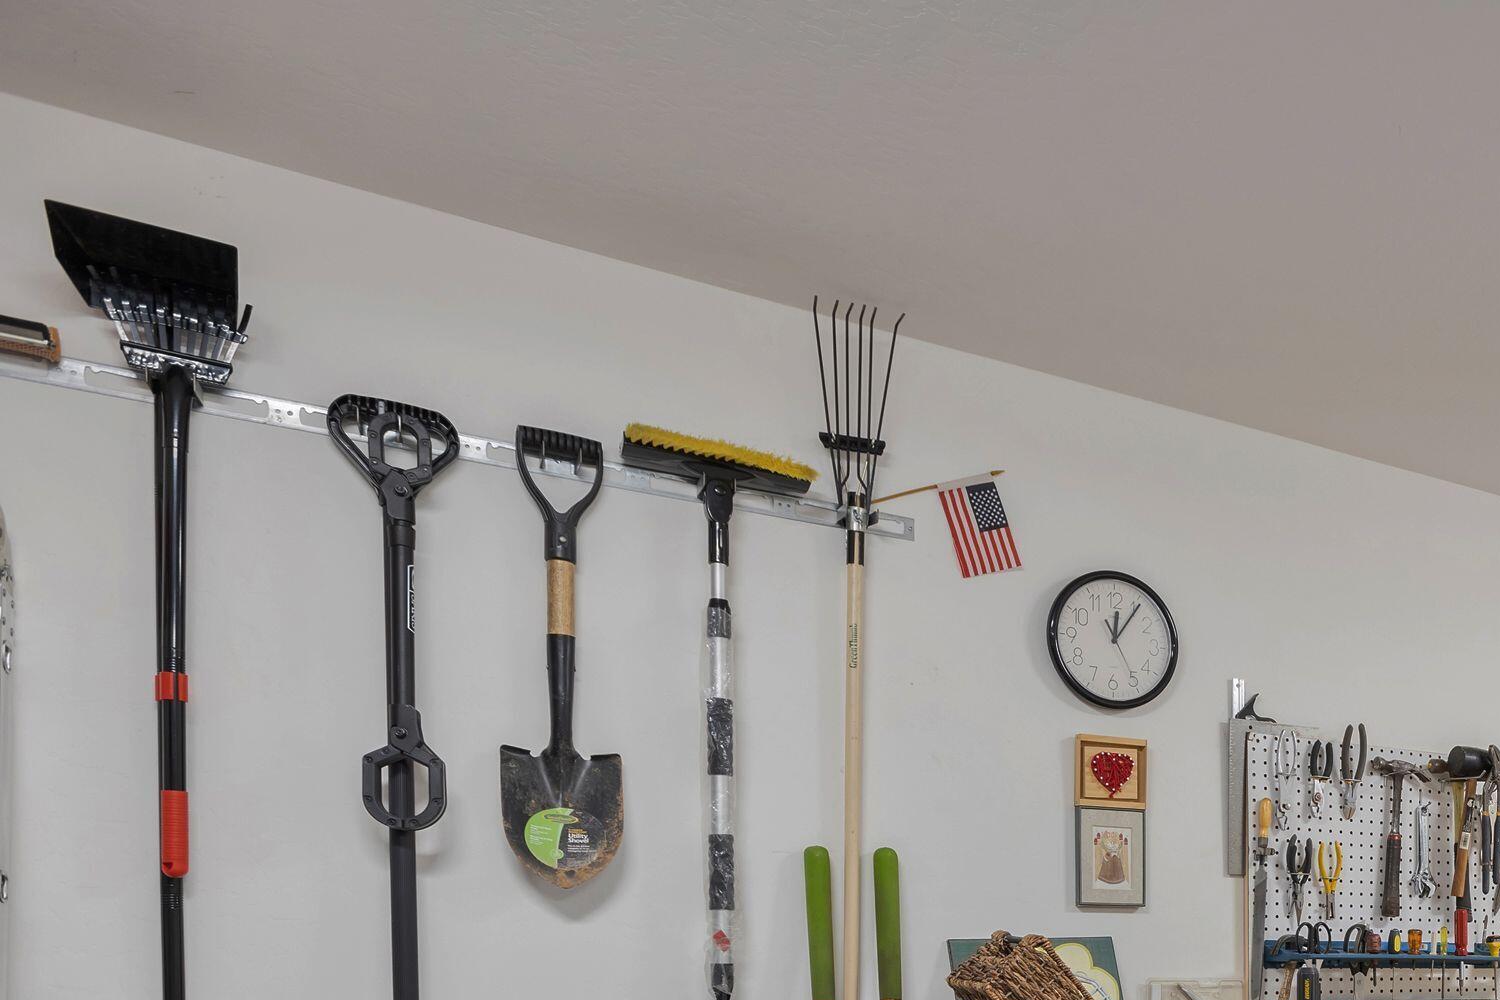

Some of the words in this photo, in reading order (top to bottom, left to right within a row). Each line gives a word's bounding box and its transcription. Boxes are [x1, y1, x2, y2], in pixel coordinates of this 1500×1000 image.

[1088, 593, 1101, 612] 11
[1106, 591, 1123, 610] 12
[1071, 607, 1089, 626] 10
[1141, 616, 1153, 634] 2
[1065, 626, 1078, 643] 9
[1072, 646, 1084, 666] 8
[1148, 638, 1160, 656] 3
[1089, 665, 1098, 681] 7
[1140, 659, 1152, 675] 4
[1107, 673, 1119, 690] 6
[1127, 670, 1139, 688] 5
